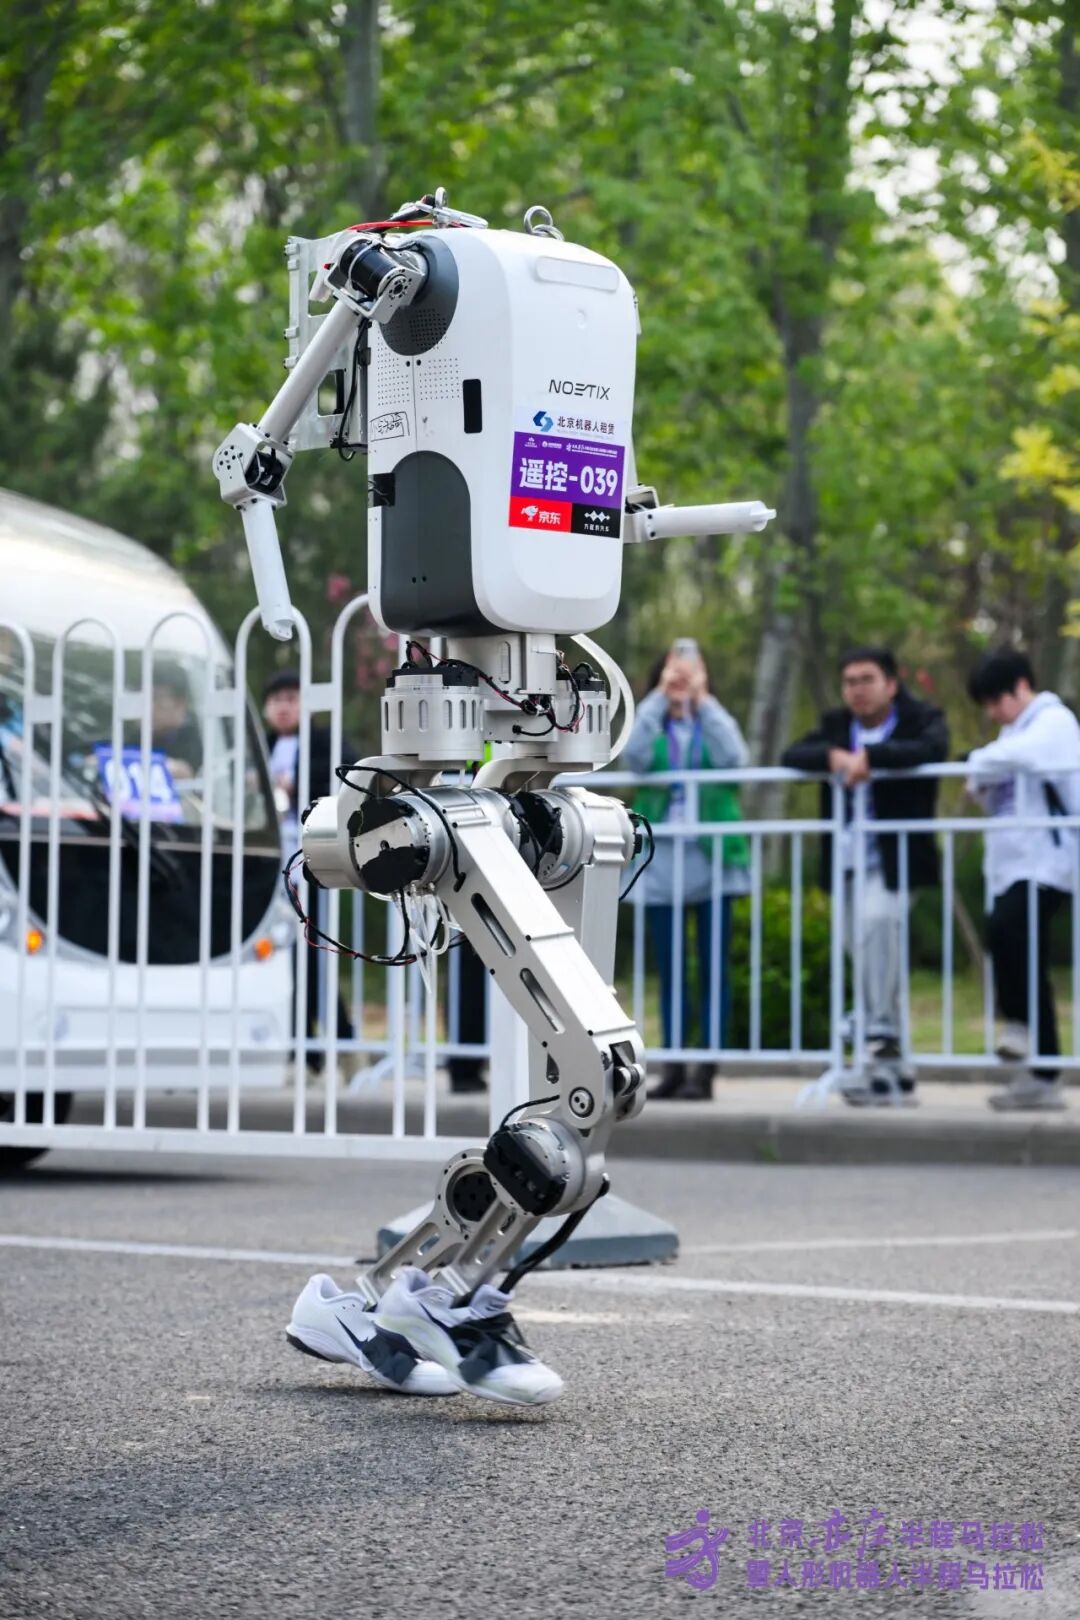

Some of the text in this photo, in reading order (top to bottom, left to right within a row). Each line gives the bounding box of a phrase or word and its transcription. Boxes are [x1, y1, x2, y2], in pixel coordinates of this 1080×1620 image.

[548, 379, 610, 400] NOETIX
[557, 416, 615, 434] 北京机器人租赁
[519, 458, 618, 496] 遥控-039
[539, 511, 561, 525] 京东
